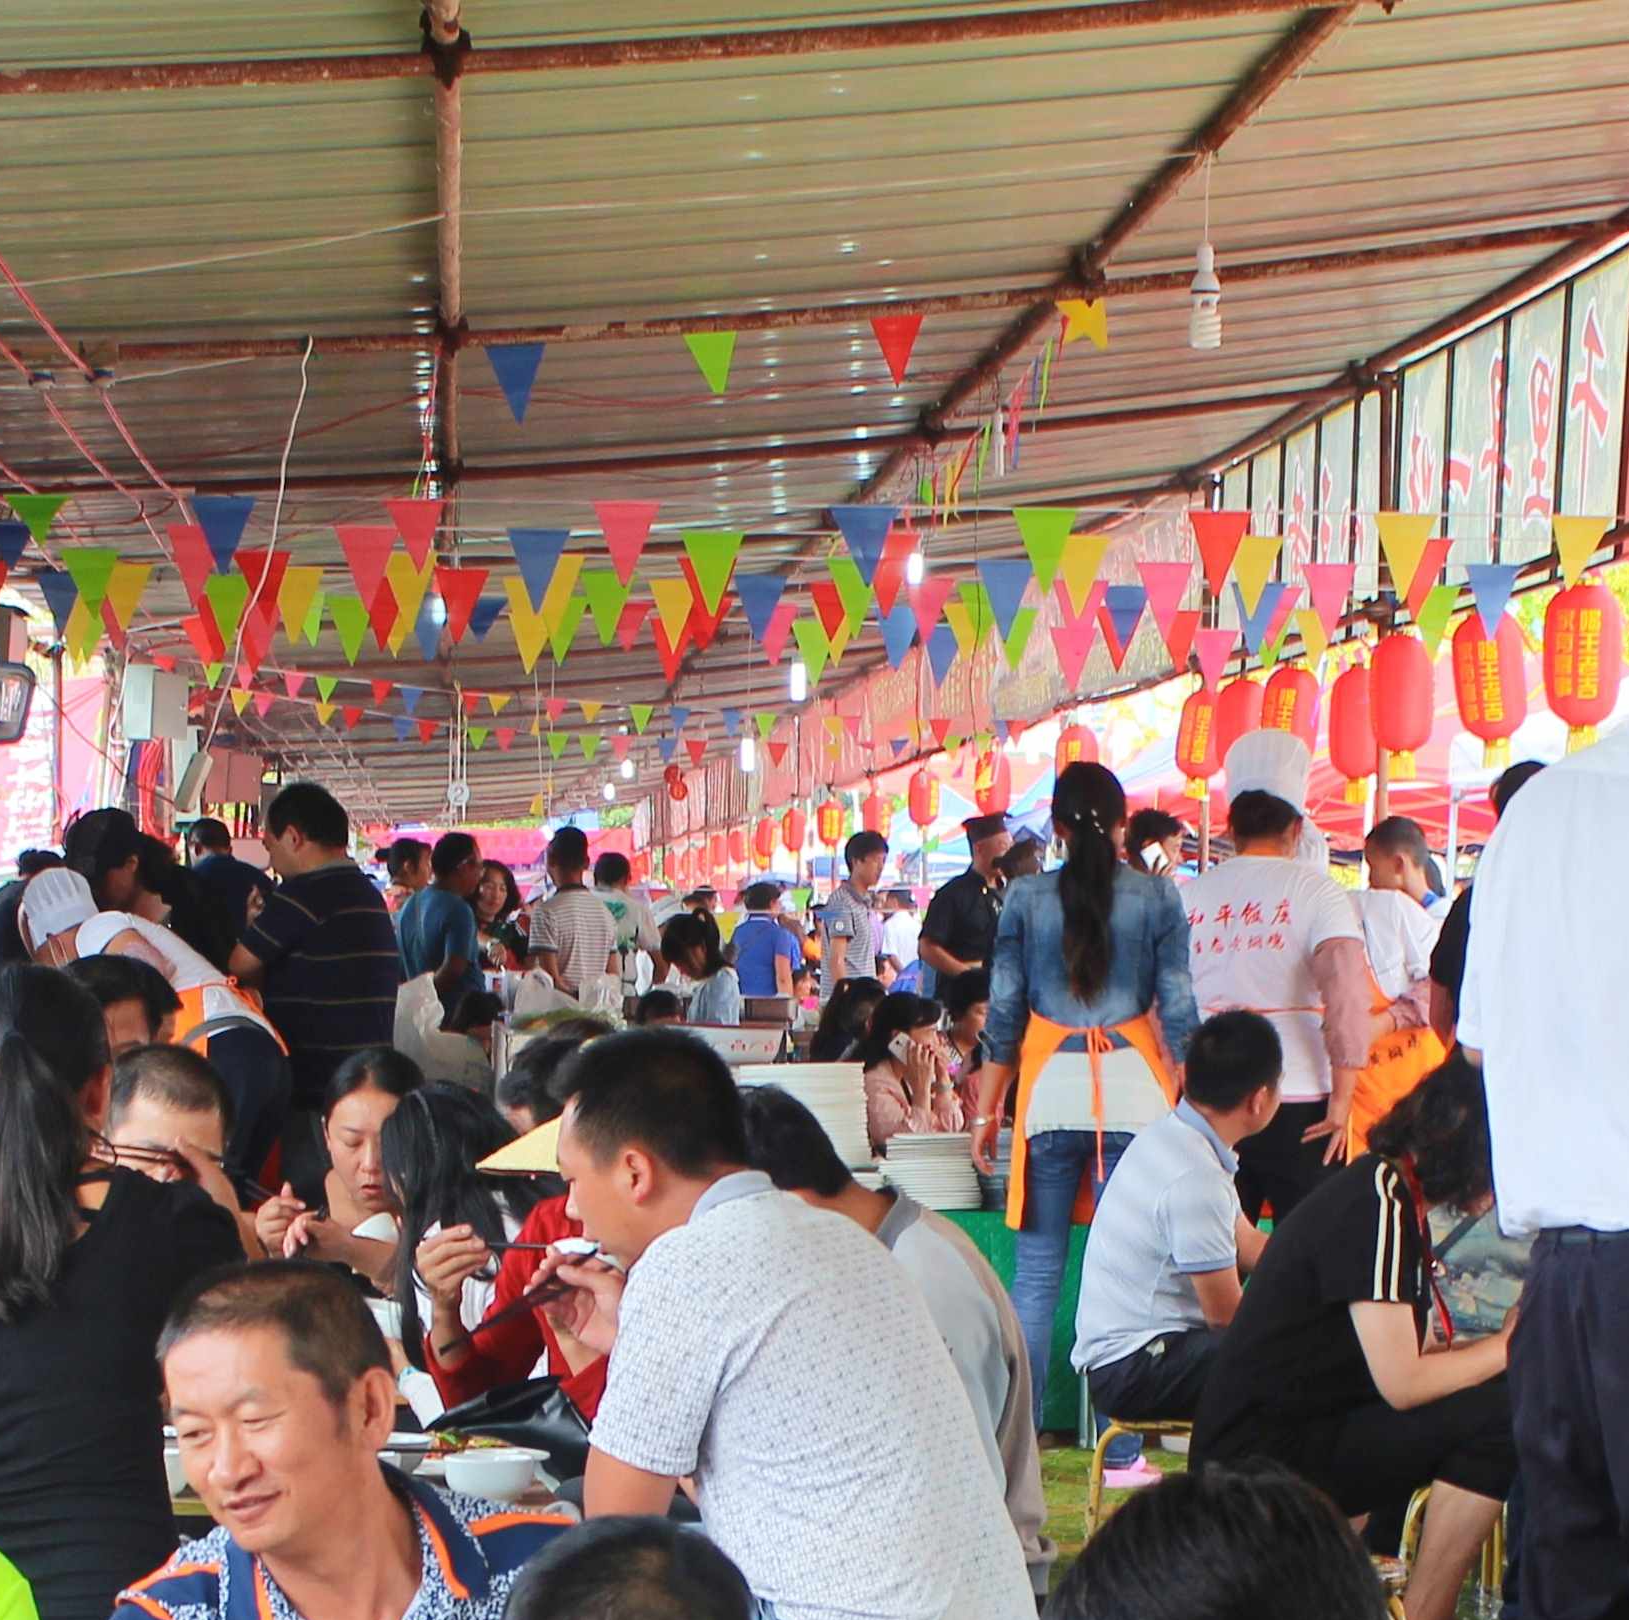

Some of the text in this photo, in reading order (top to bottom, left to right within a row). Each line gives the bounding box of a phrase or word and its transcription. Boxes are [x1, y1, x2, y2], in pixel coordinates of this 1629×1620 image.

[1577, 608, 1602, 699] 喝王老吉
[1186, 897, 1293, 930] 和平饭庄
